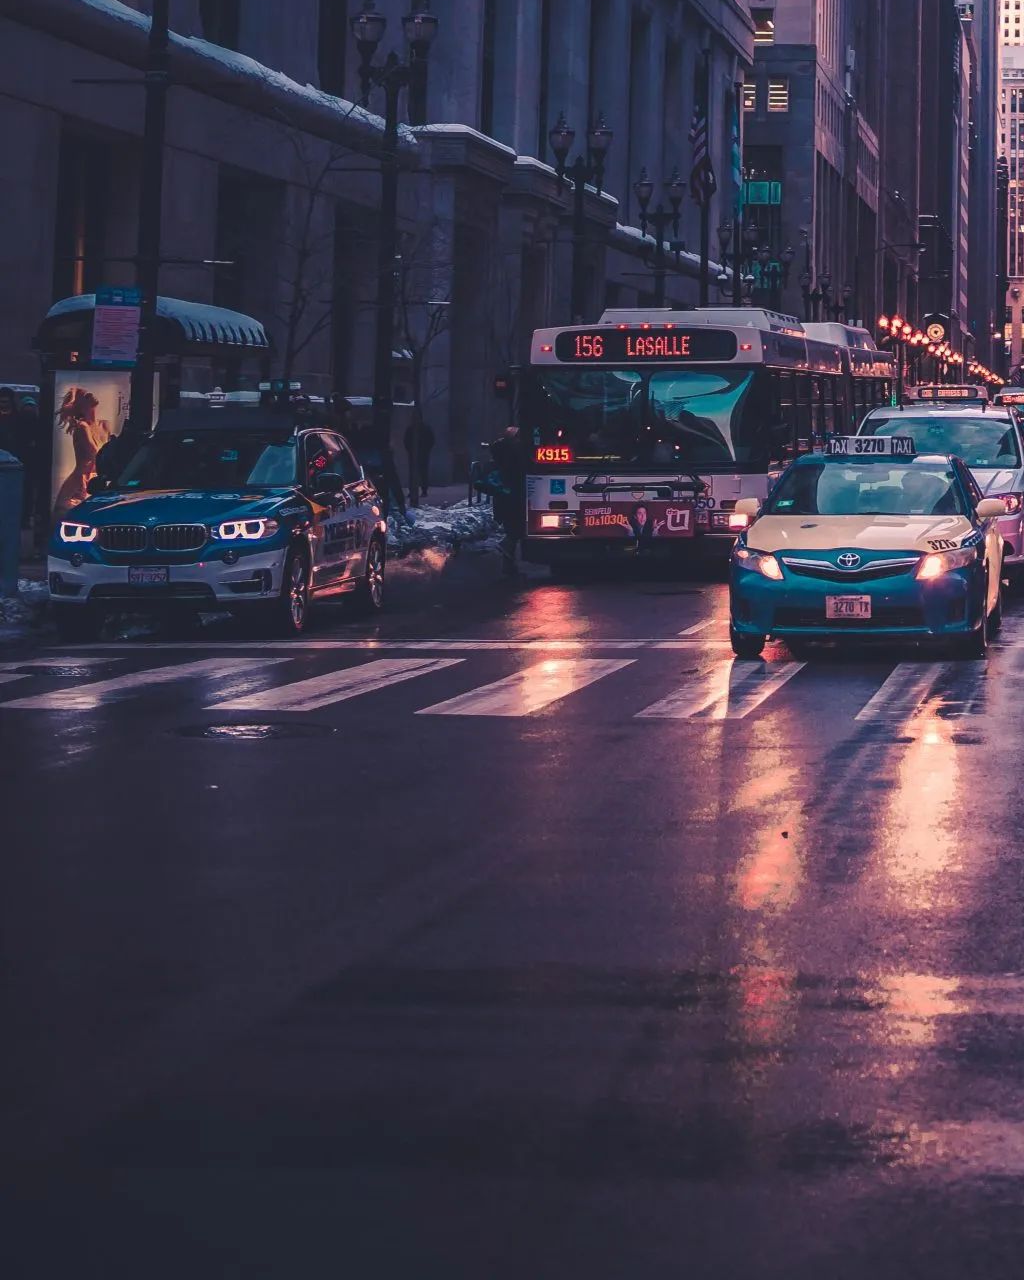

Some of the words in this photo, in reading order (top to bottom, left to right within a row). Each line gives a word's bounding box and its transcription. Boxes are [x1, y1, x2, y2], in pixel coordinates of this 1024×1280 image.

[575, 336, 603, 356] 156
[626, 336, 690, 356] LASALLE
[829, 439, 849, 454] TAXI
[854, 438, 885, 454] 3270
[892, 439, 912, 454] TAXI
[536, 448, 570, 462] K915
[833, 601, 855, 613] 3270
[859, 601, 870, 613] TX
